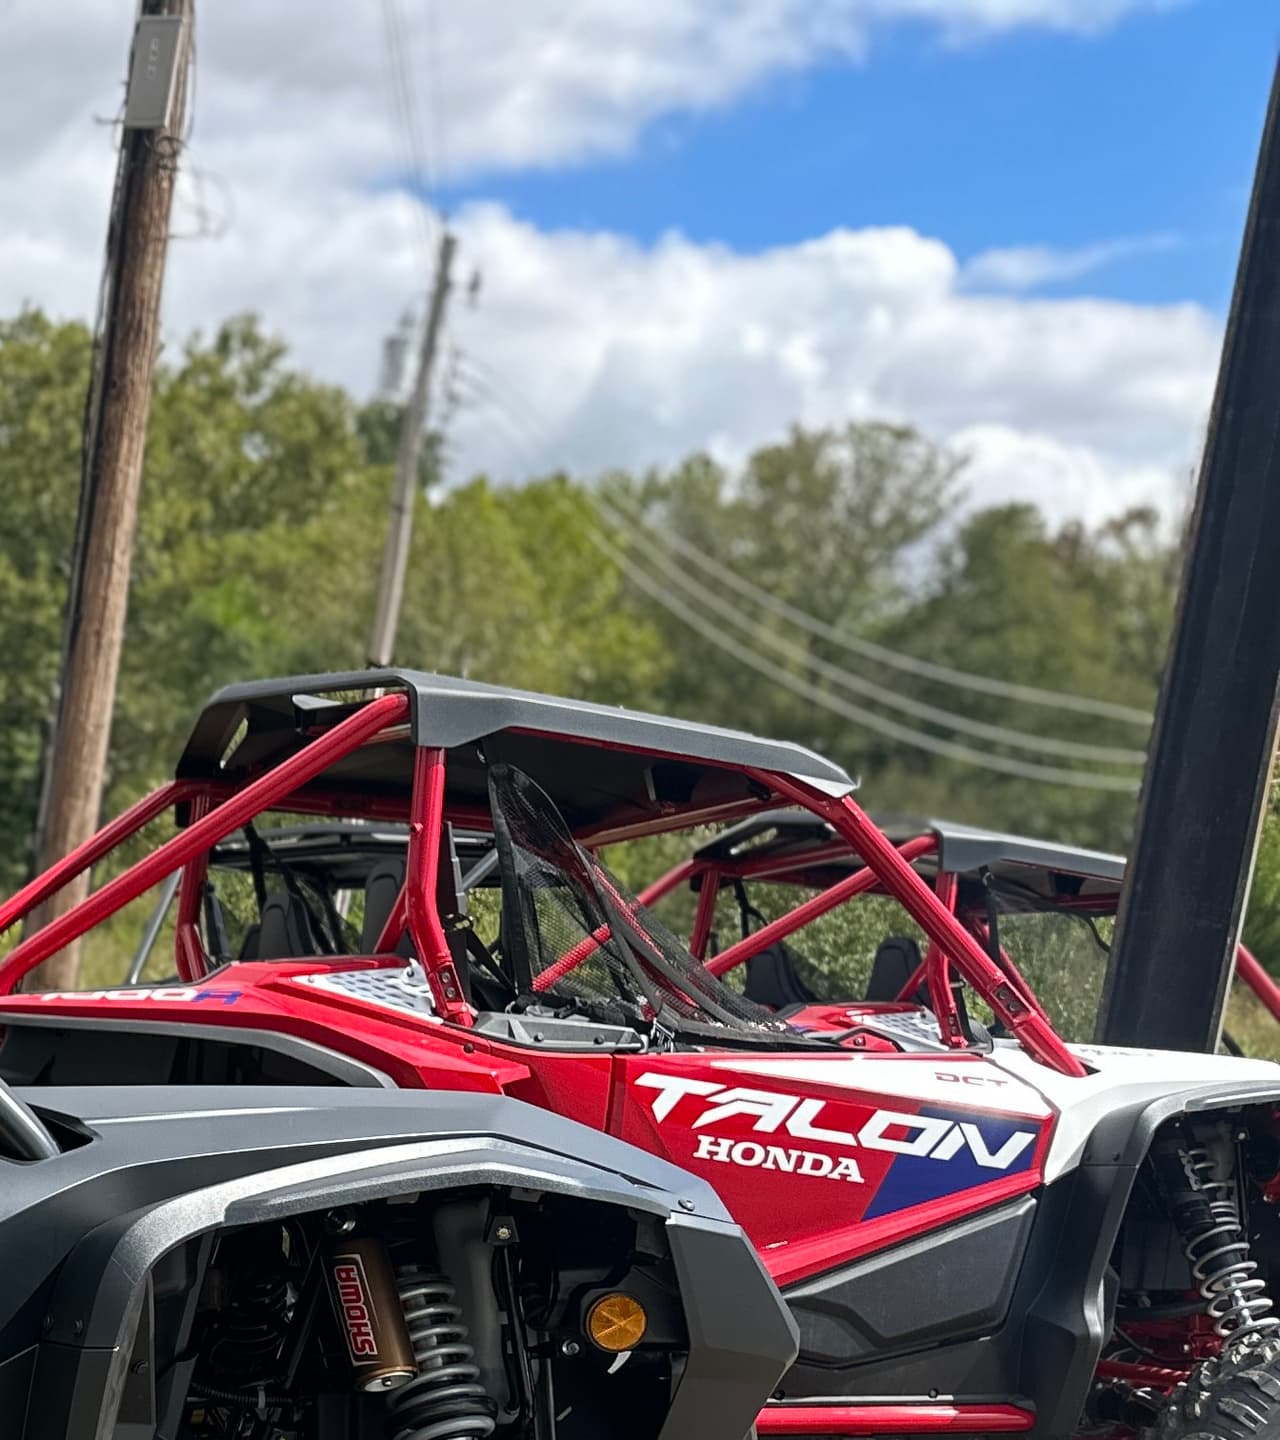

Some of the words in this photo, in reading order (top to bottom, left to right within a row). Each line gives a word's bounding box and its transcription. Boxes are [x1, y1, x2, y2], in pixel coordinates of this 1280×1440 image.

[934, 1071, 1009, 1088] DCT
[633, 1072, 1037, 1170] TALON
[692, 1134, 865, 1185] HONDA
[333, 1264, 379, 1356] SHOWA
